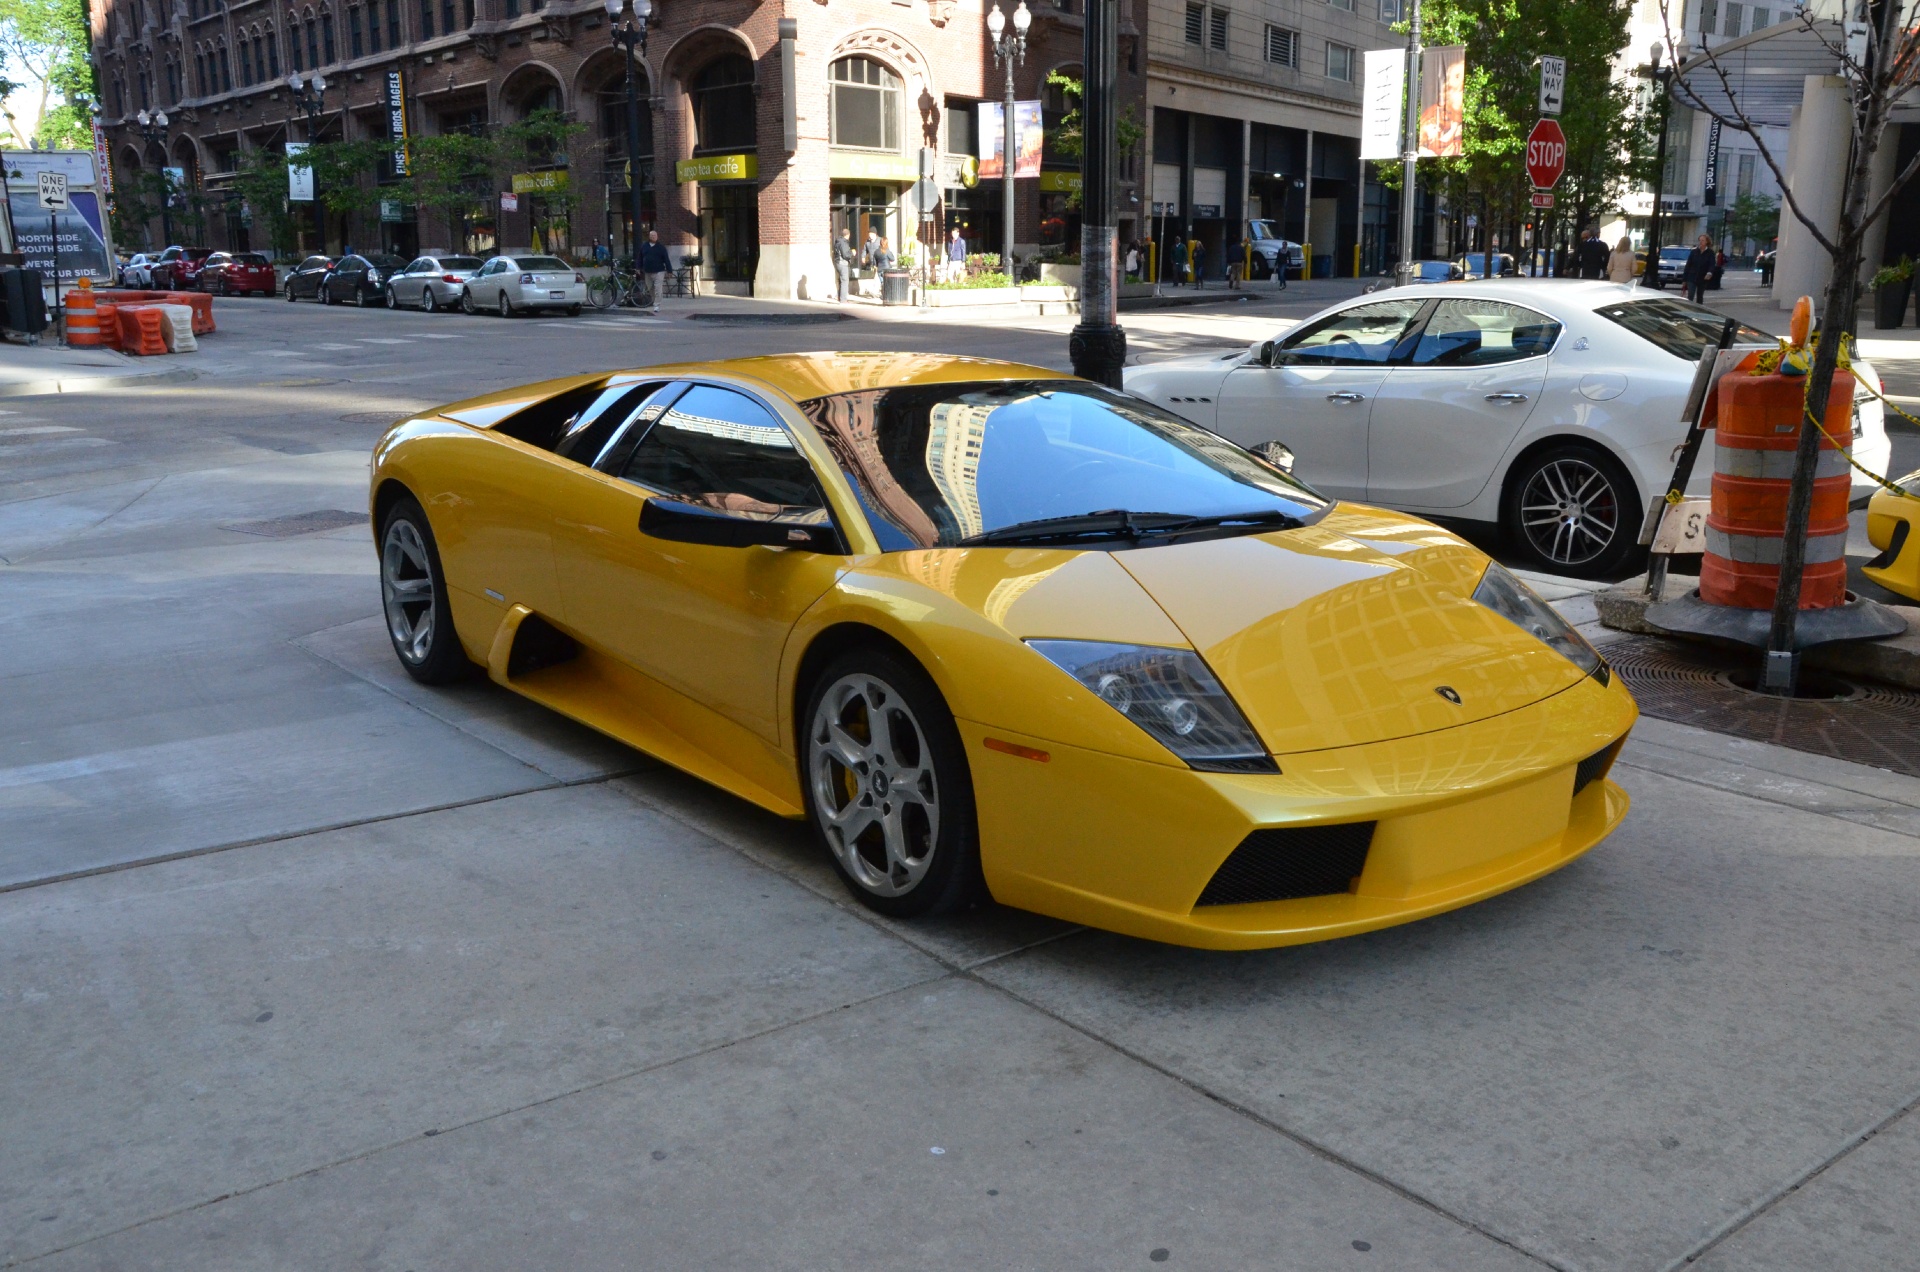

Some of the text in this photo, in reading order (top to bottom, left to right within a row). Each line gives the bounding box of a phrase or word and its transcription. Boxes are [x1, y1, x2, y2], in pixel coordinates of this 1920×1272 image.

[1545, 61, 1562, 76] ONE
[389, 72, 402, 107] BAGELS
[1543, 76, 1562, 91] WAY
[392, 108, 404, 132] BROS.
[1528, 140, 1563, 167] STOP
[1705, 117, 1719, 190] ORDSTROM rack
[698, 163, 711, 176] tea
[713, 156, 739, 174] café
[41, 175, 64, 186] ONE
[535, 172, 555, 188] café
[41, 185, 65, 196] WAY
[1534, 196, 1552, 206] ALL WAY
[18, 234, 82, 243] NORTH SIDE.
[57, 244, 83, 252] SIDE.
[25, 260, 55, 268] WE'RE
[44, 268, 100, 278] YOUR SIDE.
